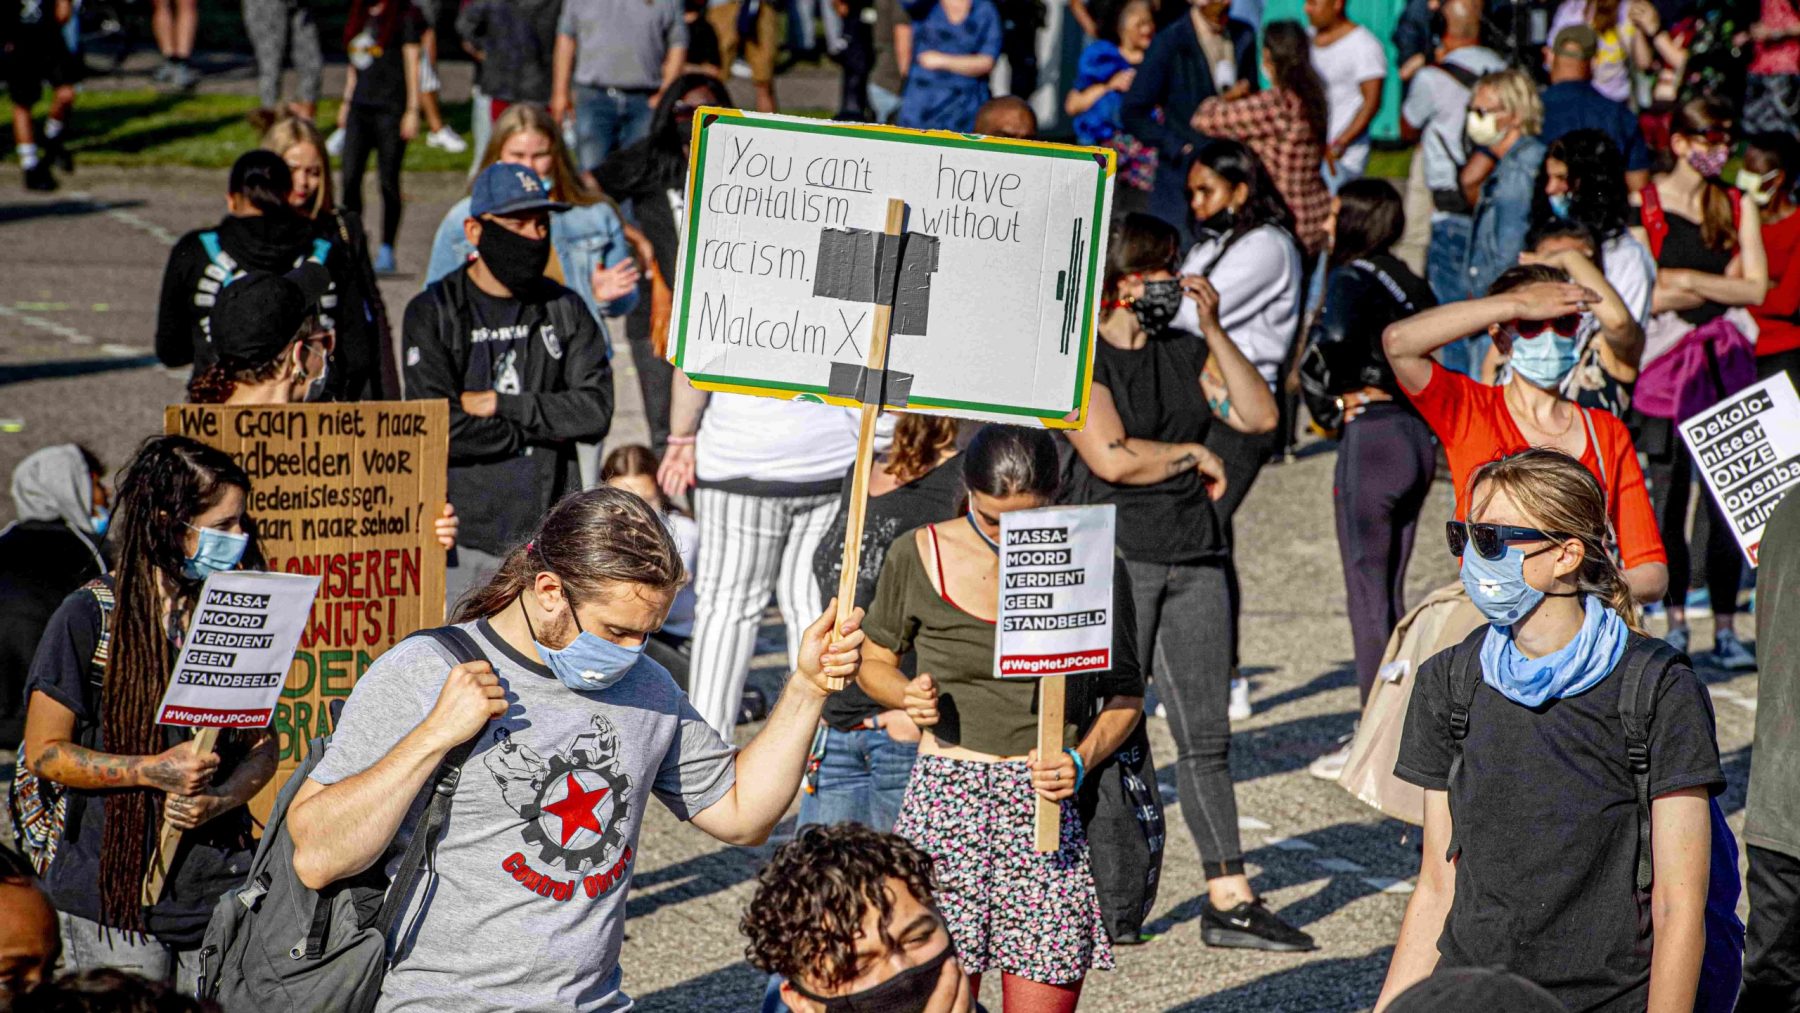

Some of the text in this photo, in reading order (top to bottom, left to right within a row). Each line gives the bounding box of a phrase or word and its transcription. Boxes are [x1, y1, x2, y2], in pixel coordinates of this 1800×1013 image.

[729, 136, 1021, 207] You can't have
[708, 183, 1021, 242] capitalism without
[702, 239, 810, 282] racism.
[698, 291, 867, 359] Malcolm X
[181, 407, 218, 436] We
[318, 410, 366, 437] niet
[1689, 396, 1770, 445] Dekolo-
[1702, 424, 1766, 467] niseer
[1713, 444, 1776, 488] ONZE
[249, 485, 394, 511] iedenislessen,
[251, 516, 293, 542] aan
[360, 502, 424, 535] school!
[1007, 530, 1067, 544] MASSA-
[1006, 552, 1067, 566] MOORD
[1006, 571, 1085, 588] VERDIENT
[207, 591, 268, 608] MASSA-
[1004, 595, 1049, 609] GEEN
[200, 611, 262, 628] MOORD
[302, 598, 396, 649] WIJS!
[1004, 611, 1106, 630] STANDBEELD
[195, 632, 274, 648] VERDIENT
[186, 651, 232, 666] GEEN
[1002, 655, 1105, 671] #WegMetJPCoen
[179, 671, 280, 687] STANDBEELD
[165, 710, 265, 724] #WegMetJPCoen
[502, 852, 575, 901] Control
